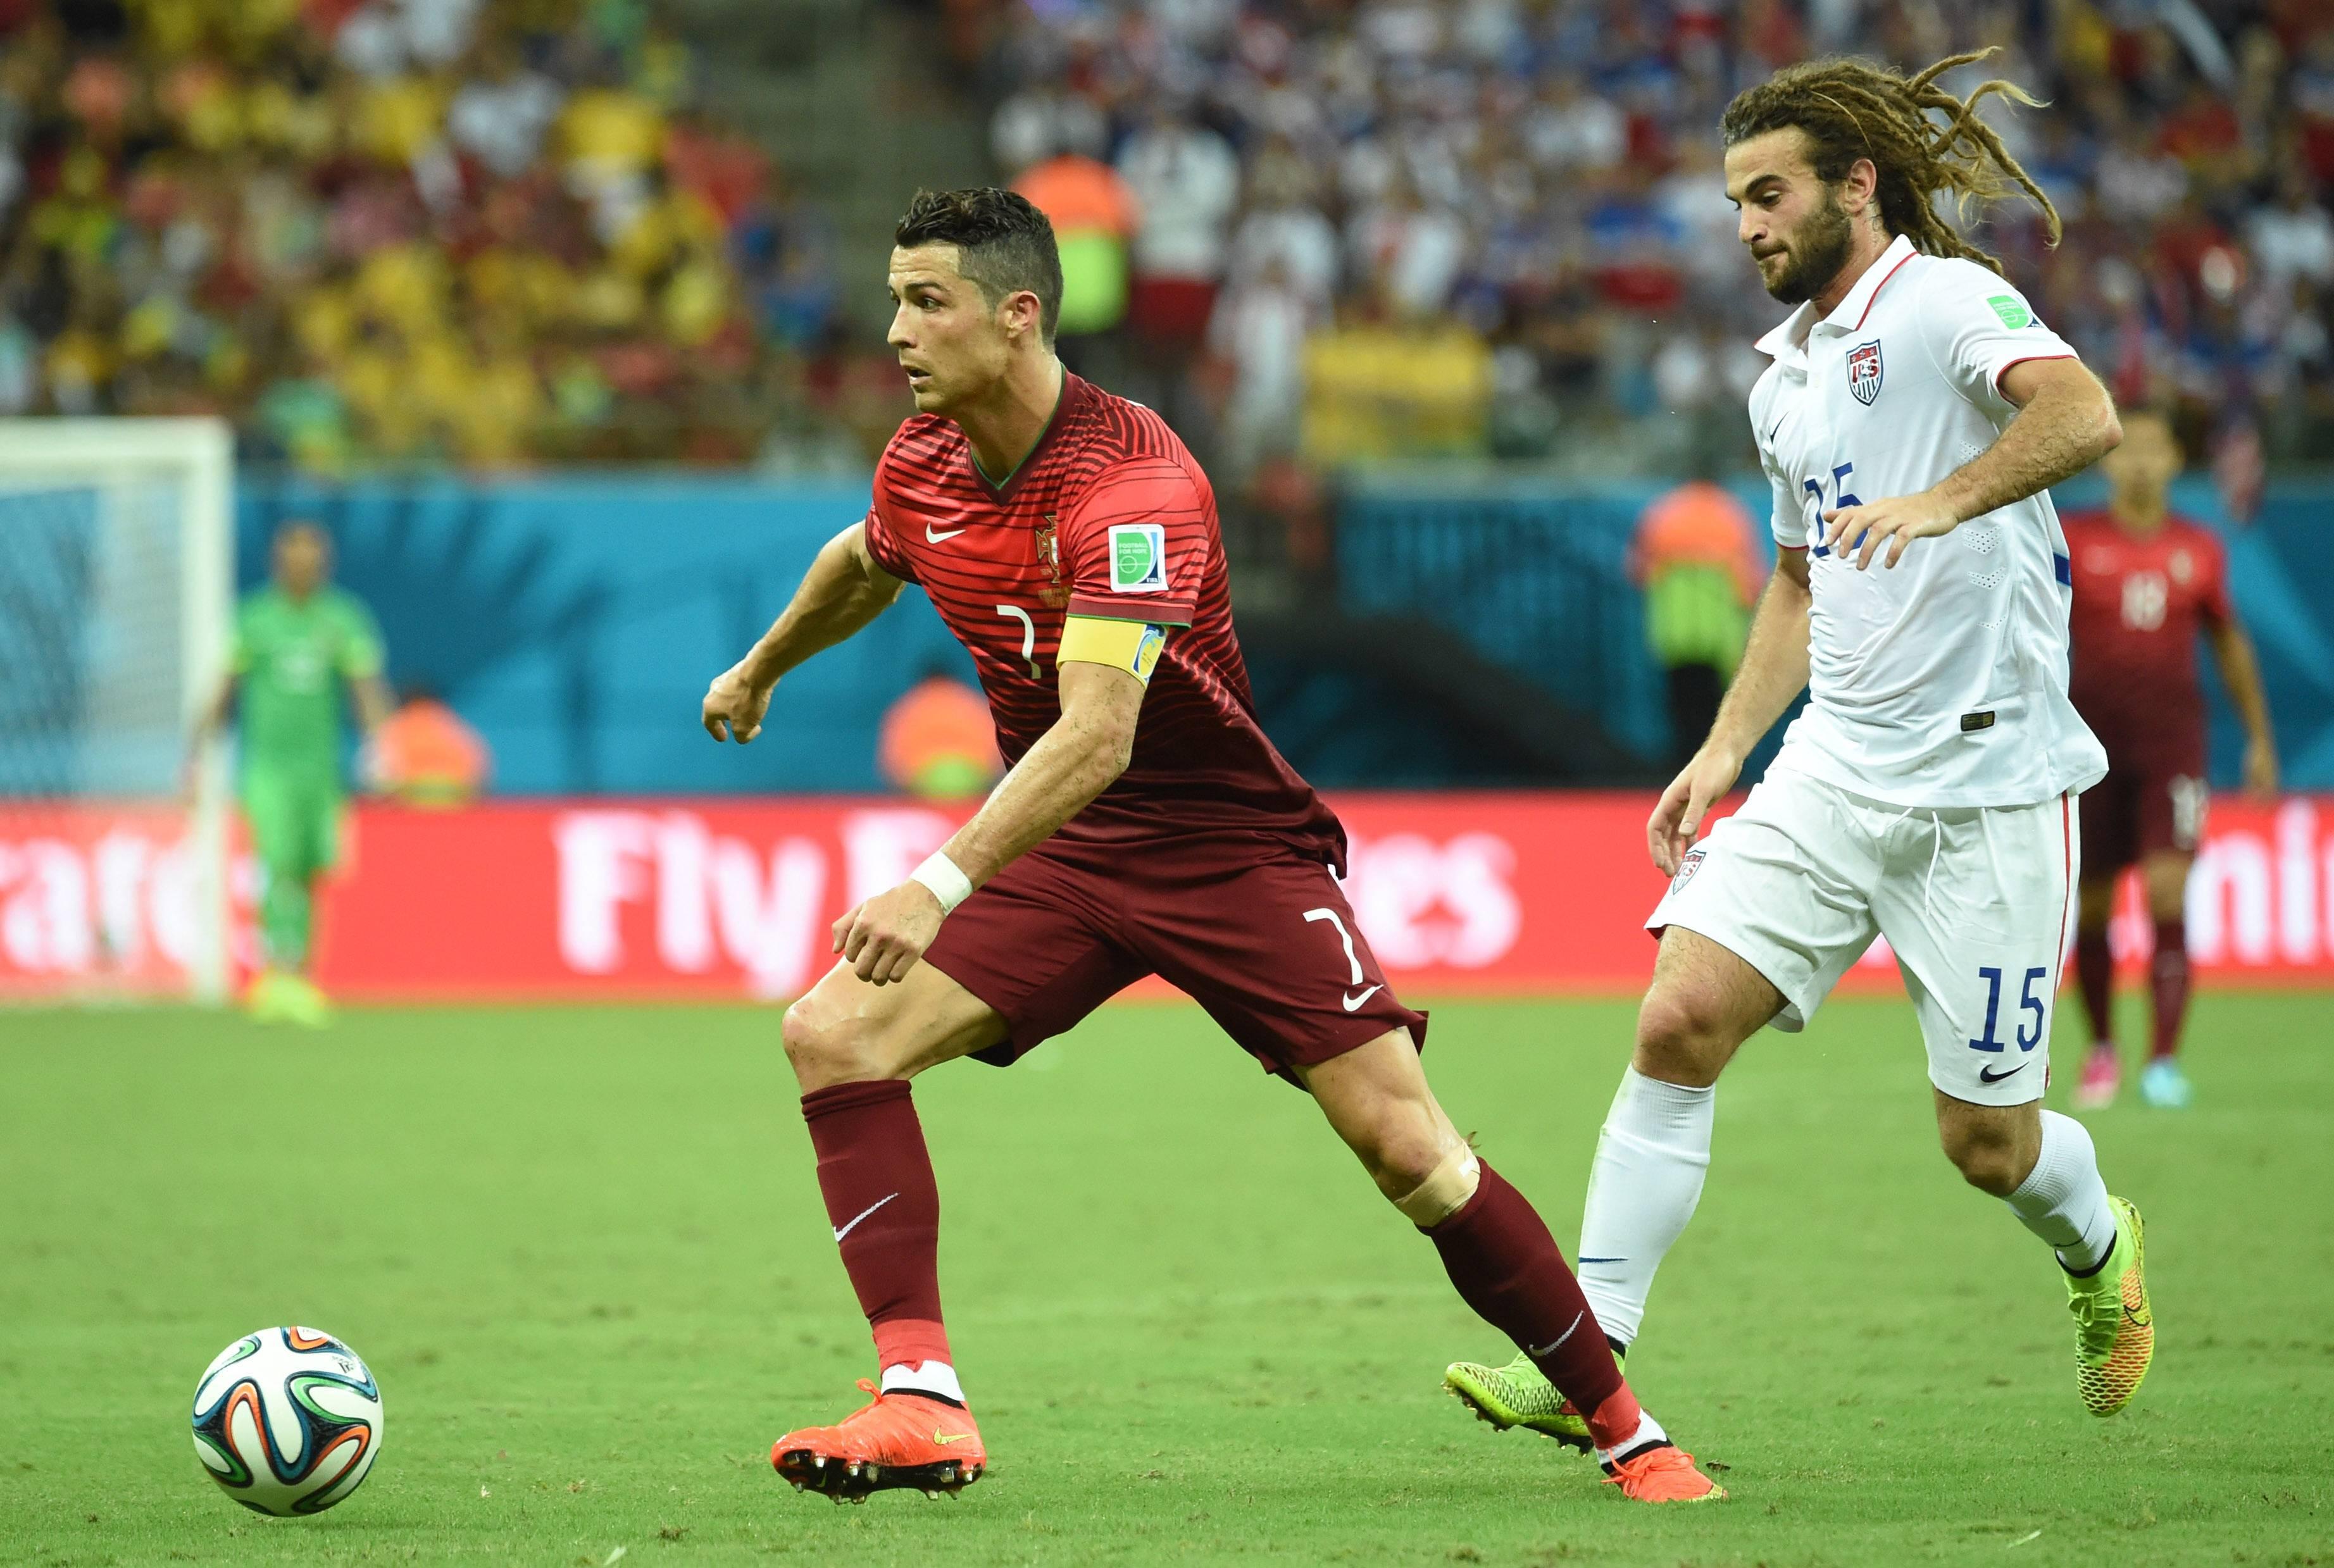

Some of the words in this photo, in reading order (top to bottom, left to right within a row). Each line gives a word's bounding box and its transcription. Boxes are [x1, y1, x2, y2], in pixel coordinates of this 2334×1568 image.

[1804, 462, 1869, 558] 15
[996, 604, 1041, 679] 7
[552, 807, 827, 1000] Fly
[1302, 907, 1364, 985] 7
[1969, 966, 2046, 1052] 15
